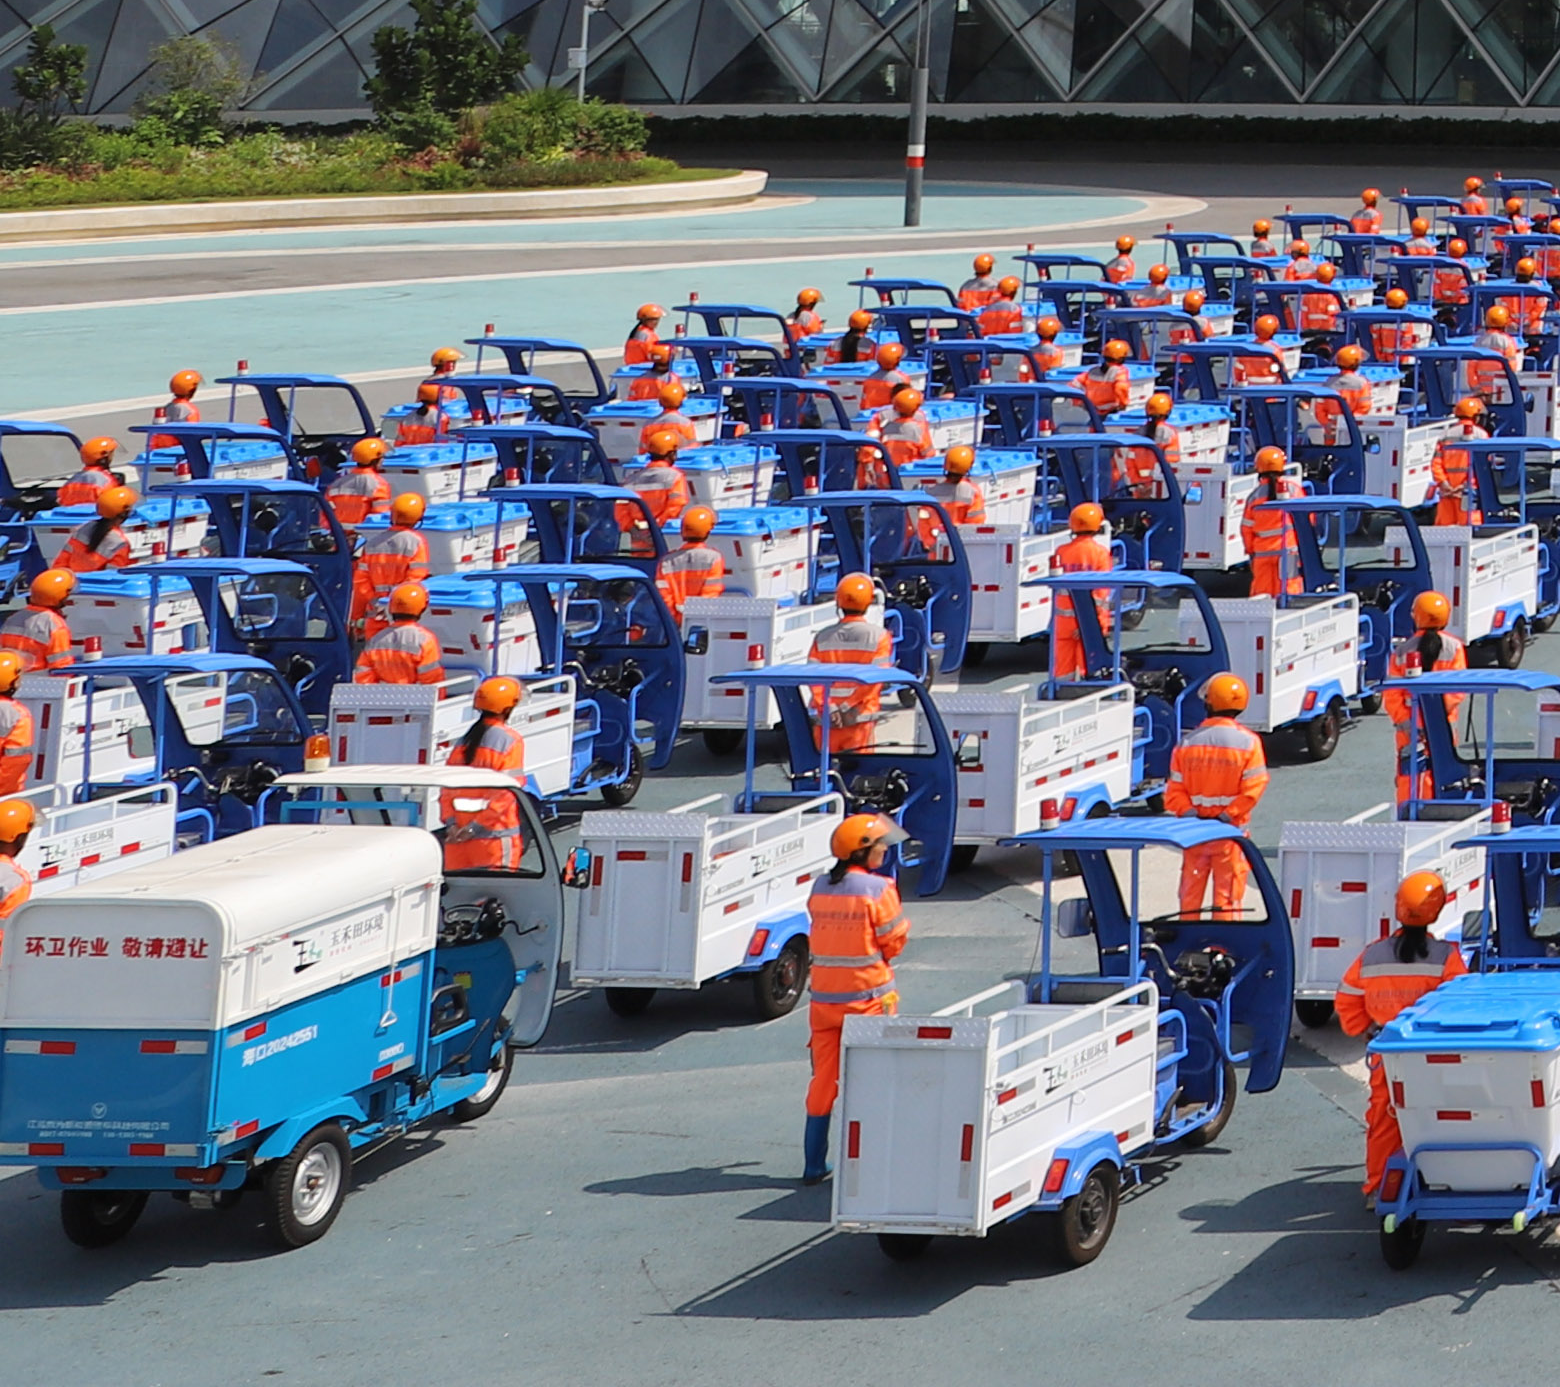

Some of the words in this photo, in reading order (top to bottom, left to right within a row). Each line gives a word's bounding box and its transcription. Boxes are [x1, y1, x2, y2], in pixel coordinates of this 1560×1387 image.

[24, 937, 109, 958] 环卫作业
[121, 937, 209, 959] 敬请避让
